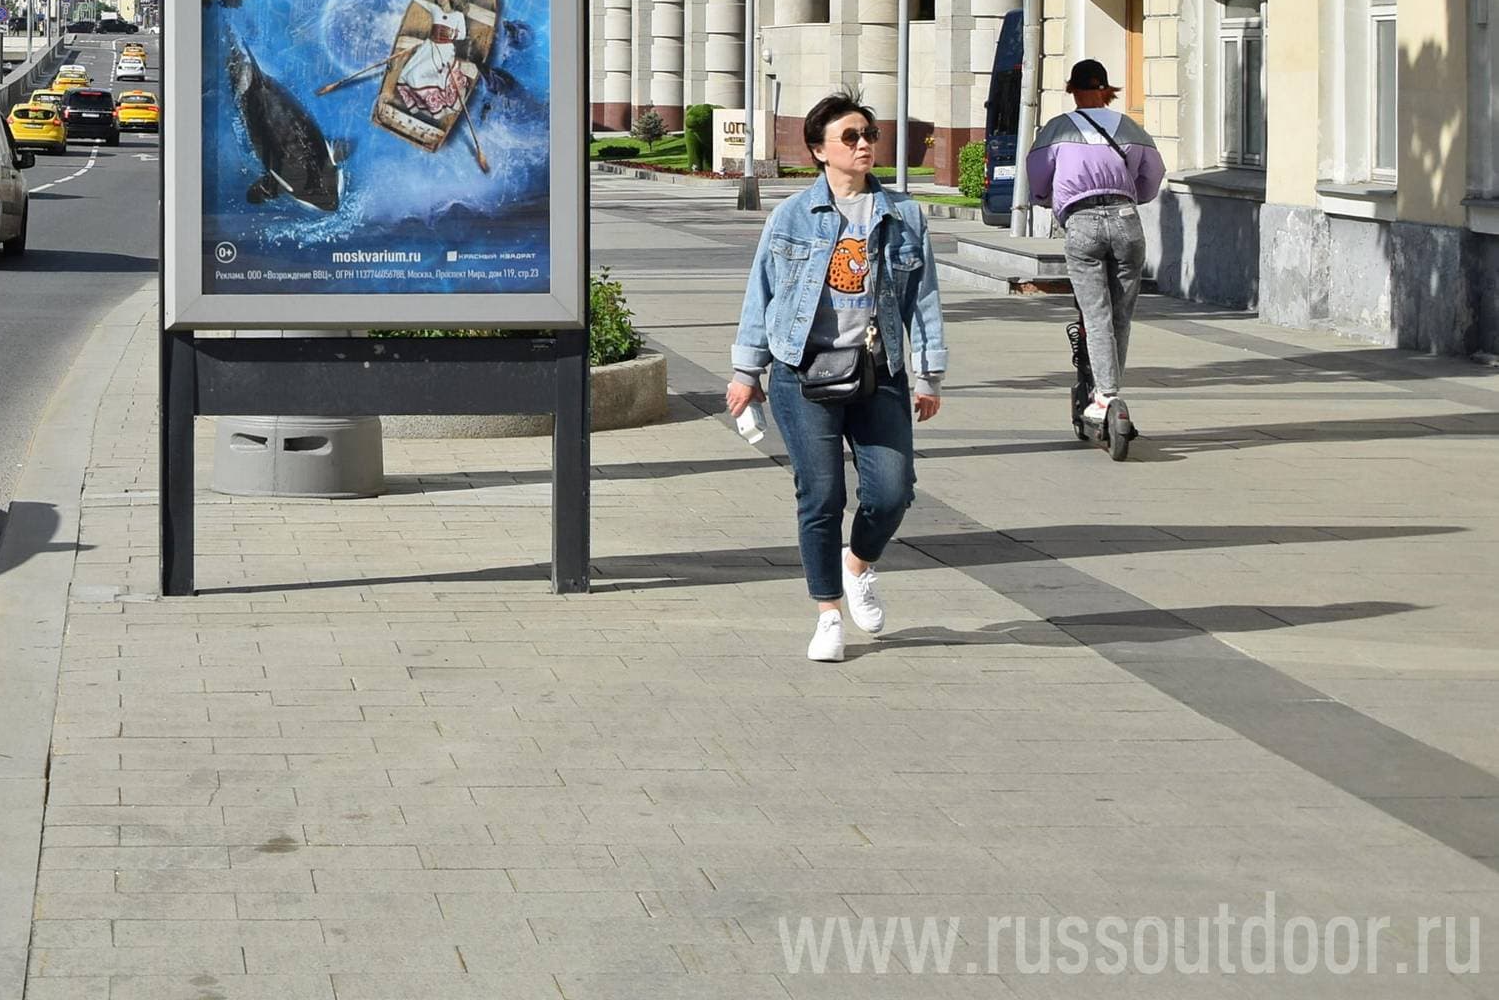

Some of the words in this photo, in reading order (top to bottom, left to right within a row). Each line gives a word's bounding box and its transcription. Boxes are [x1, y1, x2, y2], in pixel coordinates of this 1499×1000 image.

[723, 121, 747, 135] LOTT
[332, 249, 421, 263] moskvarium.ru
[247, 269, 262, 280] ООО
